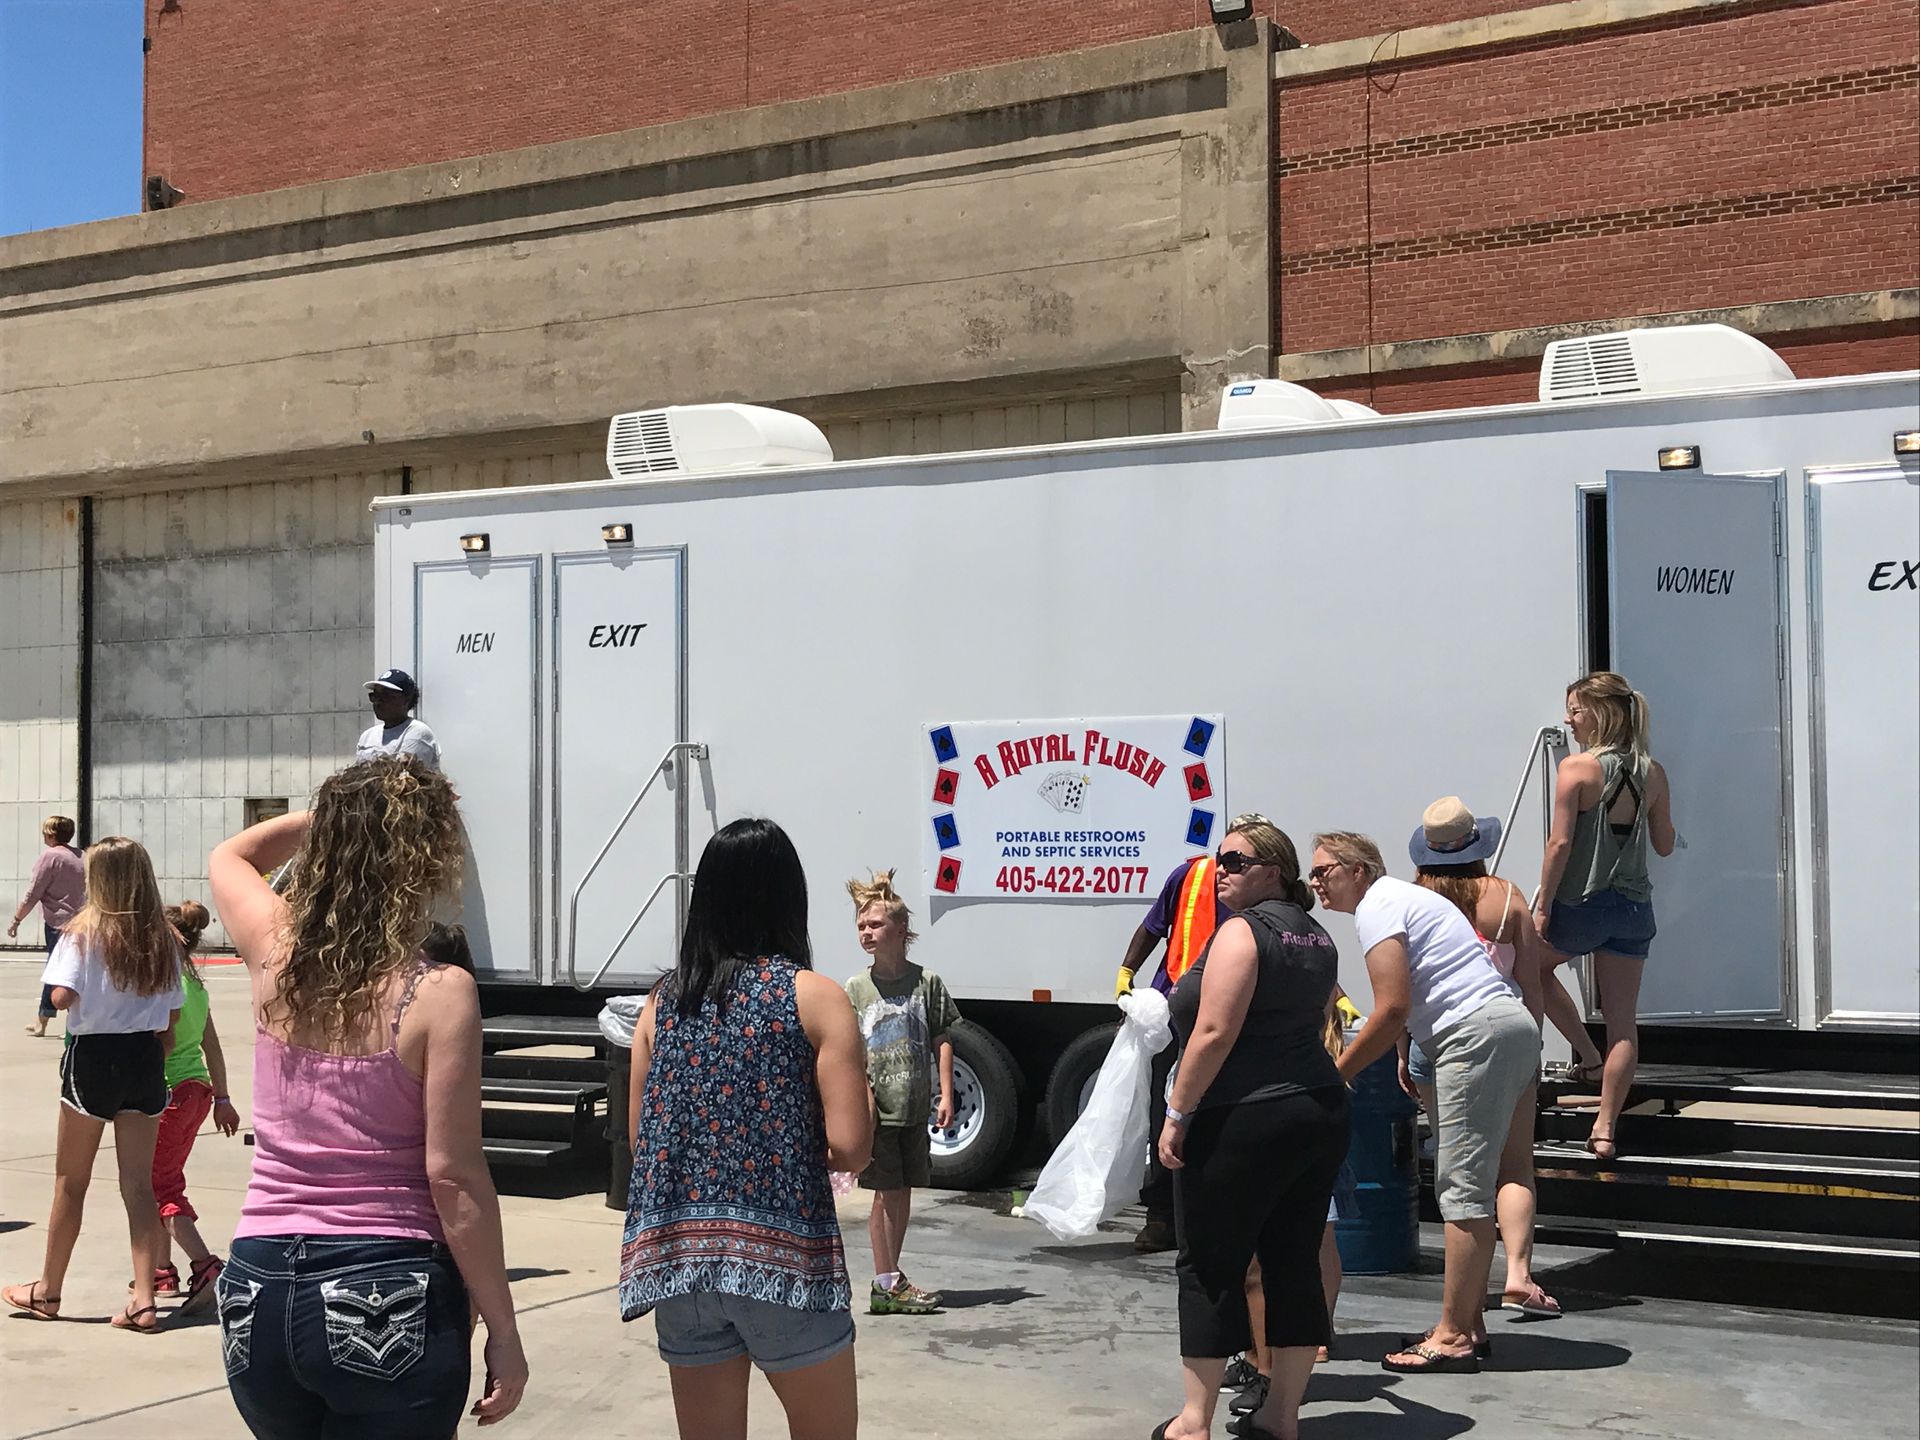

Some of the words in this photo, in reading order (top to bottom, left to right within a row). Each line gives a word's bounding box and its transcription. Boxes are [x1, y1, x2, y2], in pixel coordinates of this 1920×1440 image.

[1656, 565, 1735, 595] WOMEN
[456, 632, 496, 654] MEN
[588, 623, 648, 648] EXIT
[973, 754, 1000, 790] A
[996, 732, 1077, 778] ROYAL
[1082, 729, 1168, 789] FLUSH
[995, 831, 1060, 843] PORTABLE
[1064, 830, 1146, 842] RESTROOMS
[1002, 846, 1031, 858] AND
[1034, 846, 1076, 857] SEPTIC
[1079, 845, 1140, 858] SERVICES
[995, 866, 1149, 893] 405-422-2077
